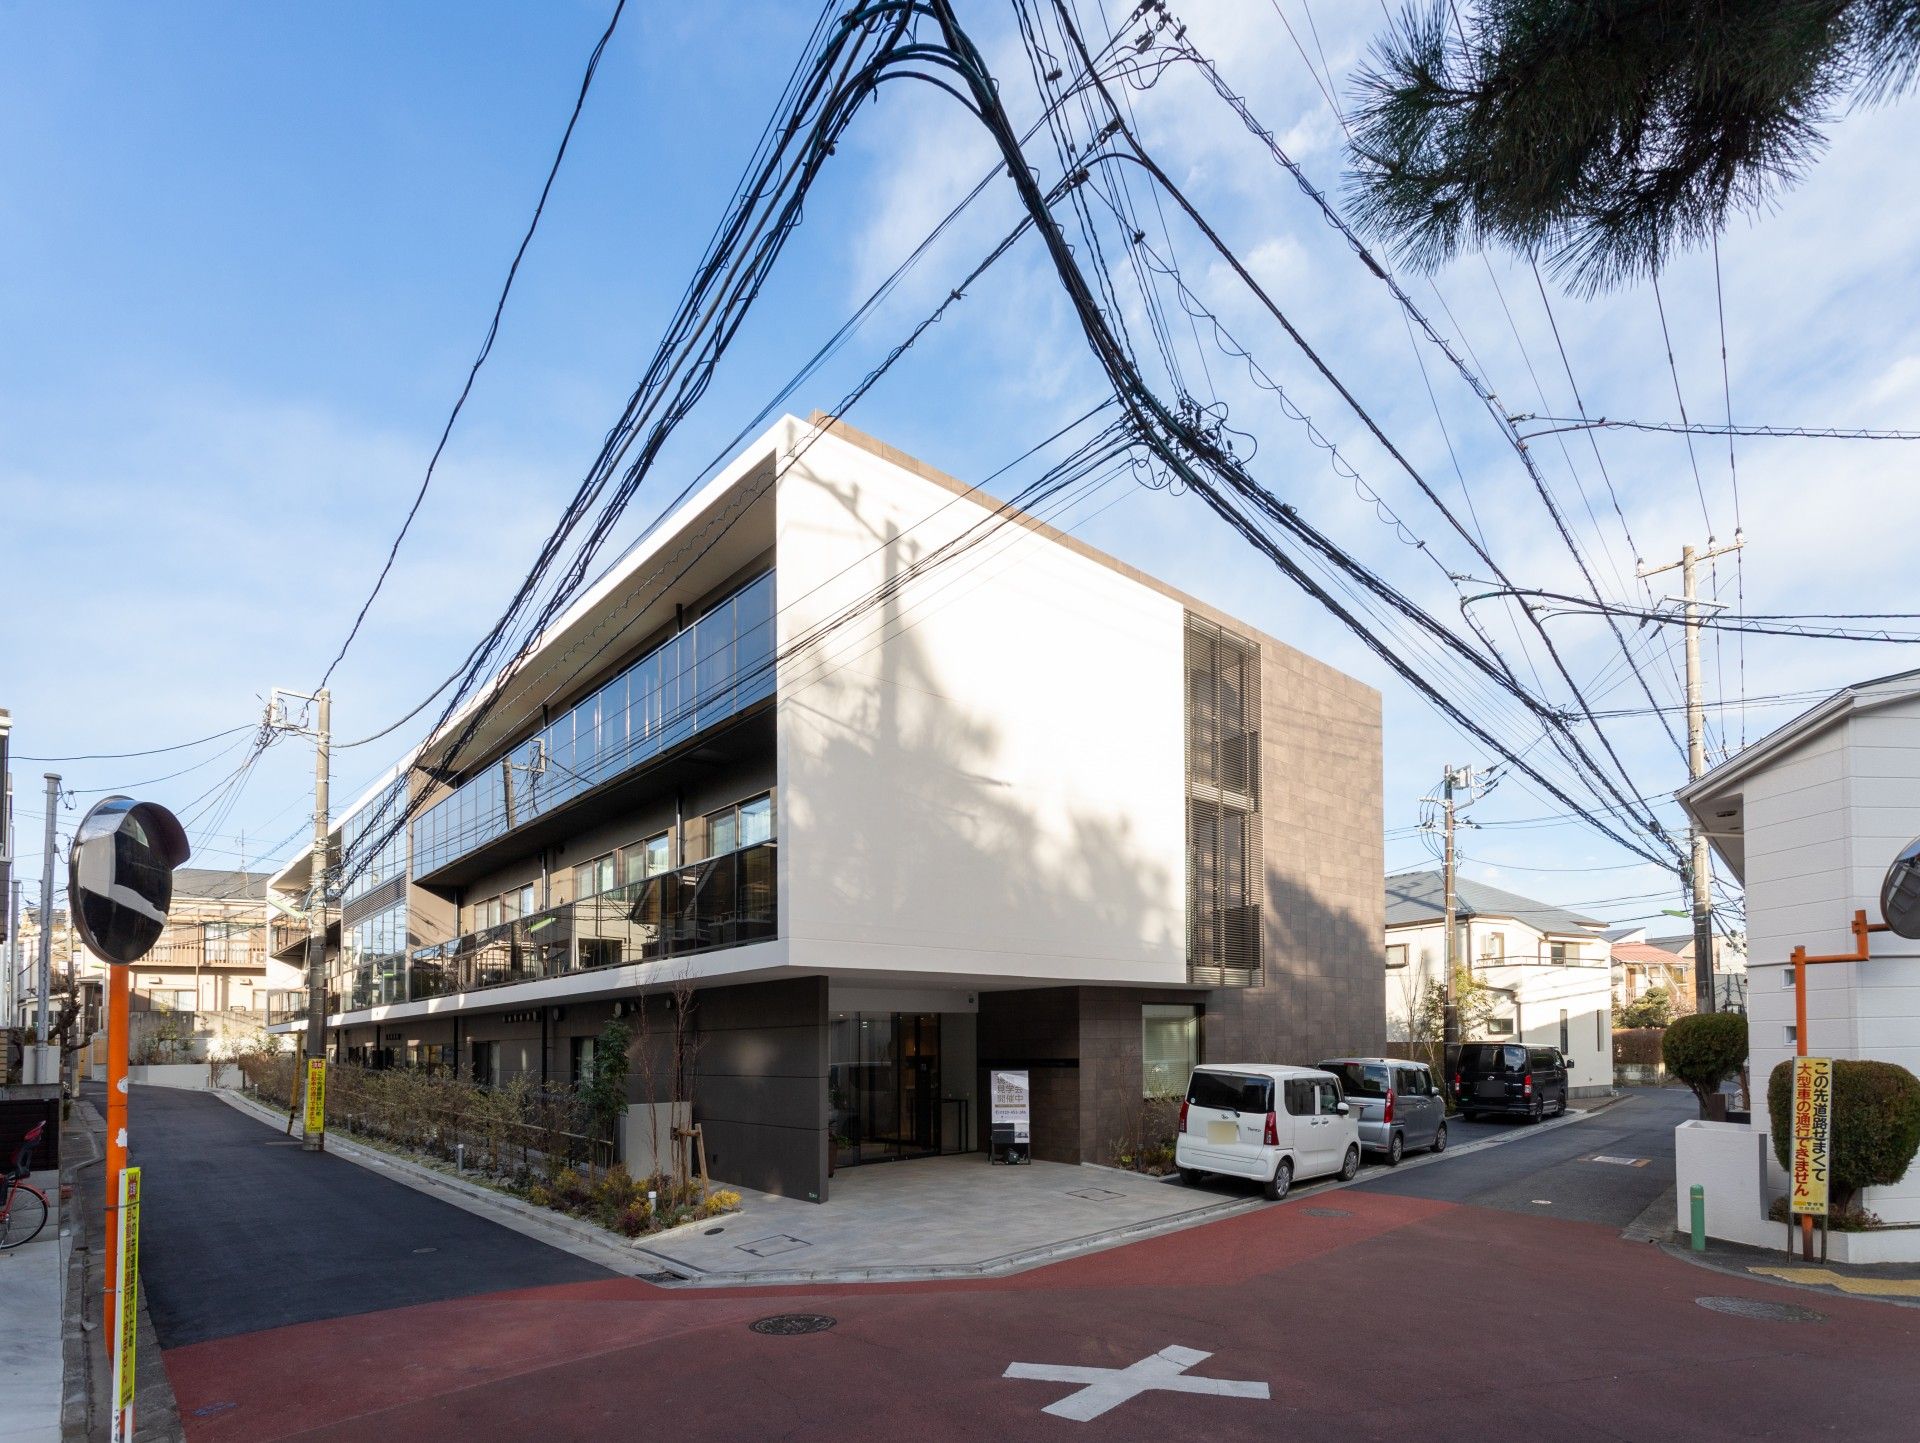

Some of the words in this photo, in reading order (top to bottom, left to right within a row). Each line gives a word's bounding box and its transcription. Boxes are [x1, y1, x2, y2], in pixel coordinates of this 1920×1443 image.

[997, 1084, 1023, 1093] 見学会
[997, 1093, 1024, 1103] 開催中
[1794, 1063, 1811, 1197] 大型車の通行できません
[1812, 1062, 1829, 1181] この先道路せまくて
